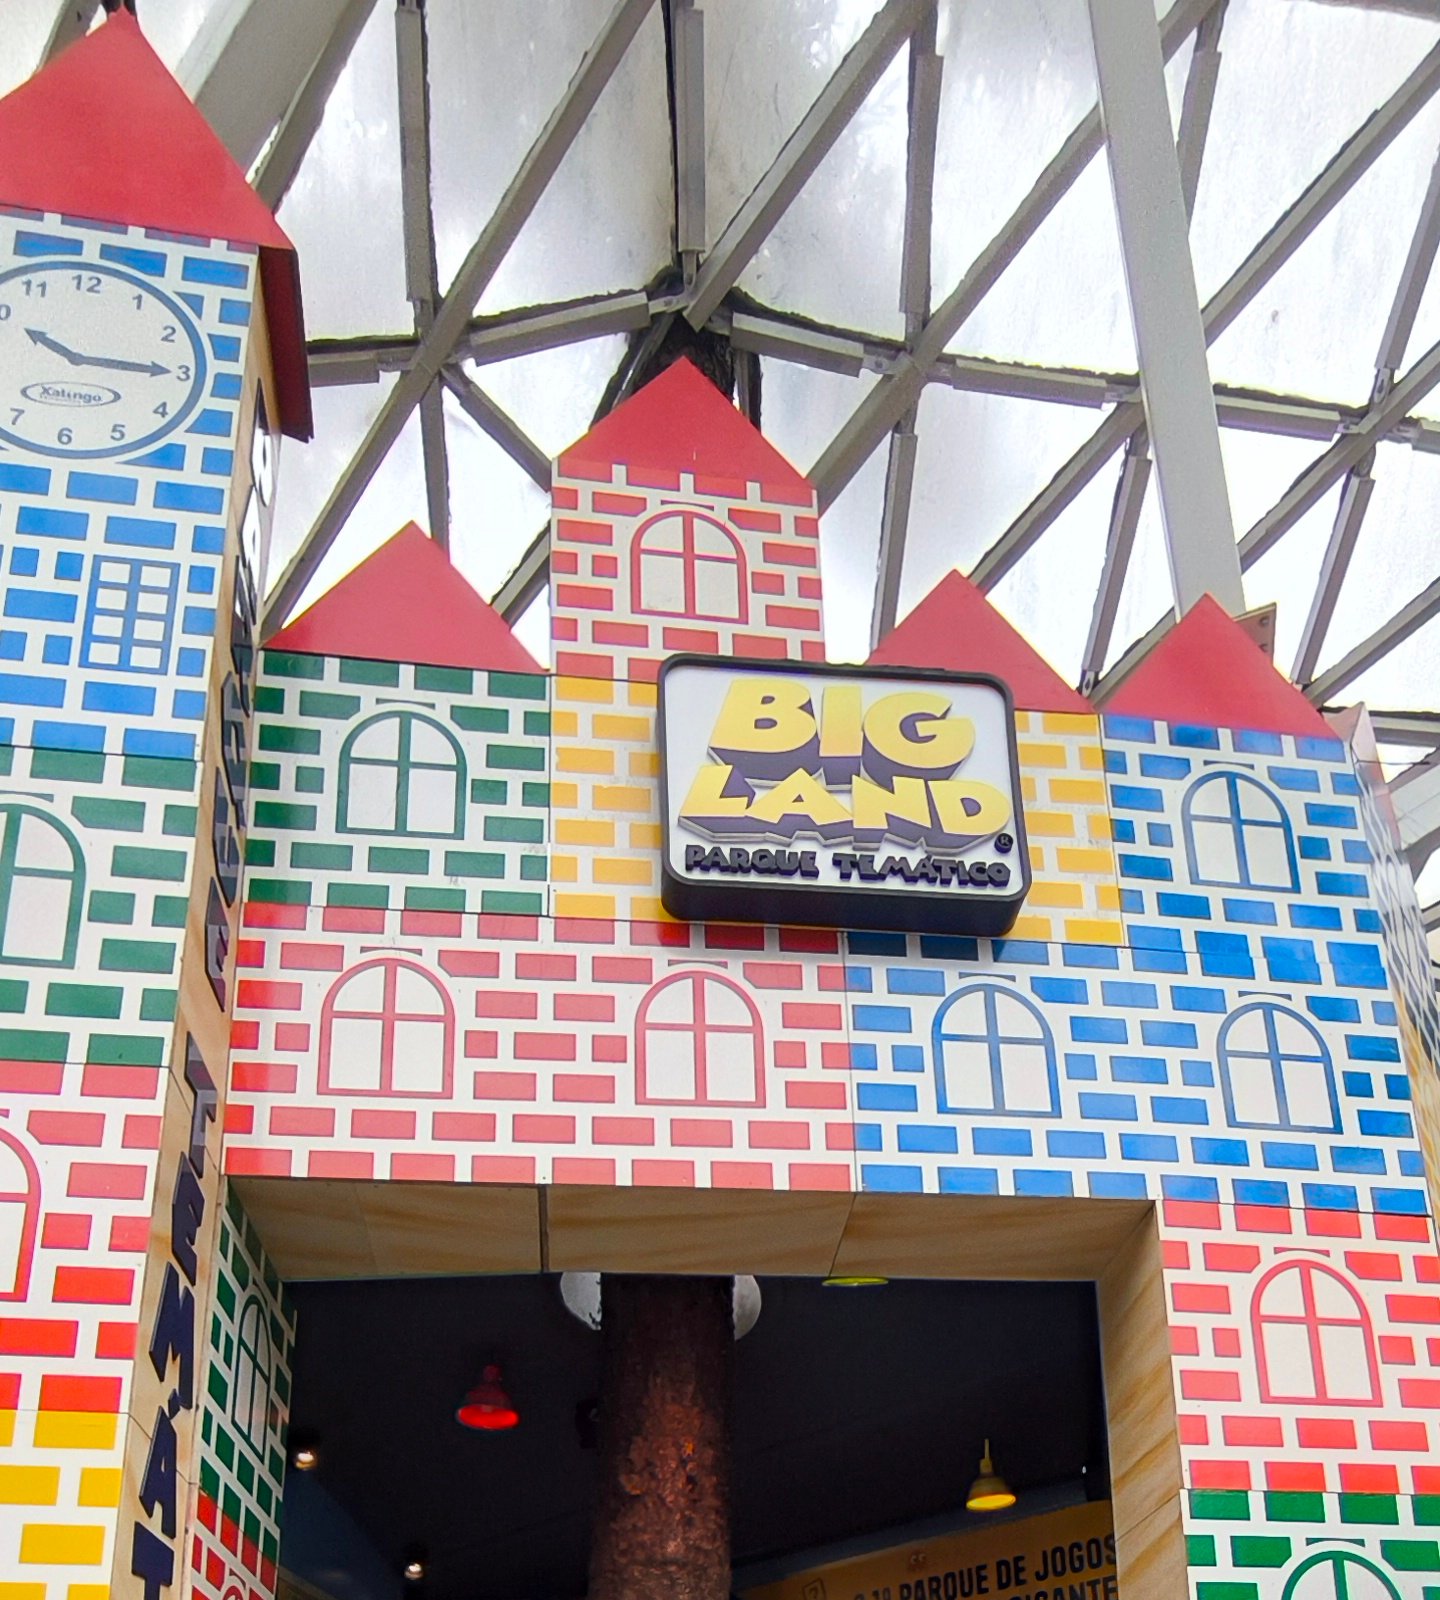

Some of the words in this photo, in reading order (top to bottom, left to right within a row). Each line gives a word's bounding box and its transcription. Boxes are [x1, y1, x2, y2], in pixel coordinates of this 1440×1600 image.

[21, 279, 48, 298] 11
[72, 275, 102, 294] 12
[133, 294, 143, 311] 1
[161, 326, 176, 342] 2
[176, 365, 191, 381] 3
[9, 409, 25, 426] 7
[153, 401, 169, 418] 4
[57, 428, 73, 446] 6
[110, 424, 126, 441] 5
[708, 678, 976, 774] BIG
[679, 764, 1012, 844] LAND
[685, 844, 820, 878] PARQUE
[832, 852, 1012, 888] TEMÁTICO
[996, 1555, 1027, 1591] DE
[1035, 1534, 1117, 1581] JOGOS
